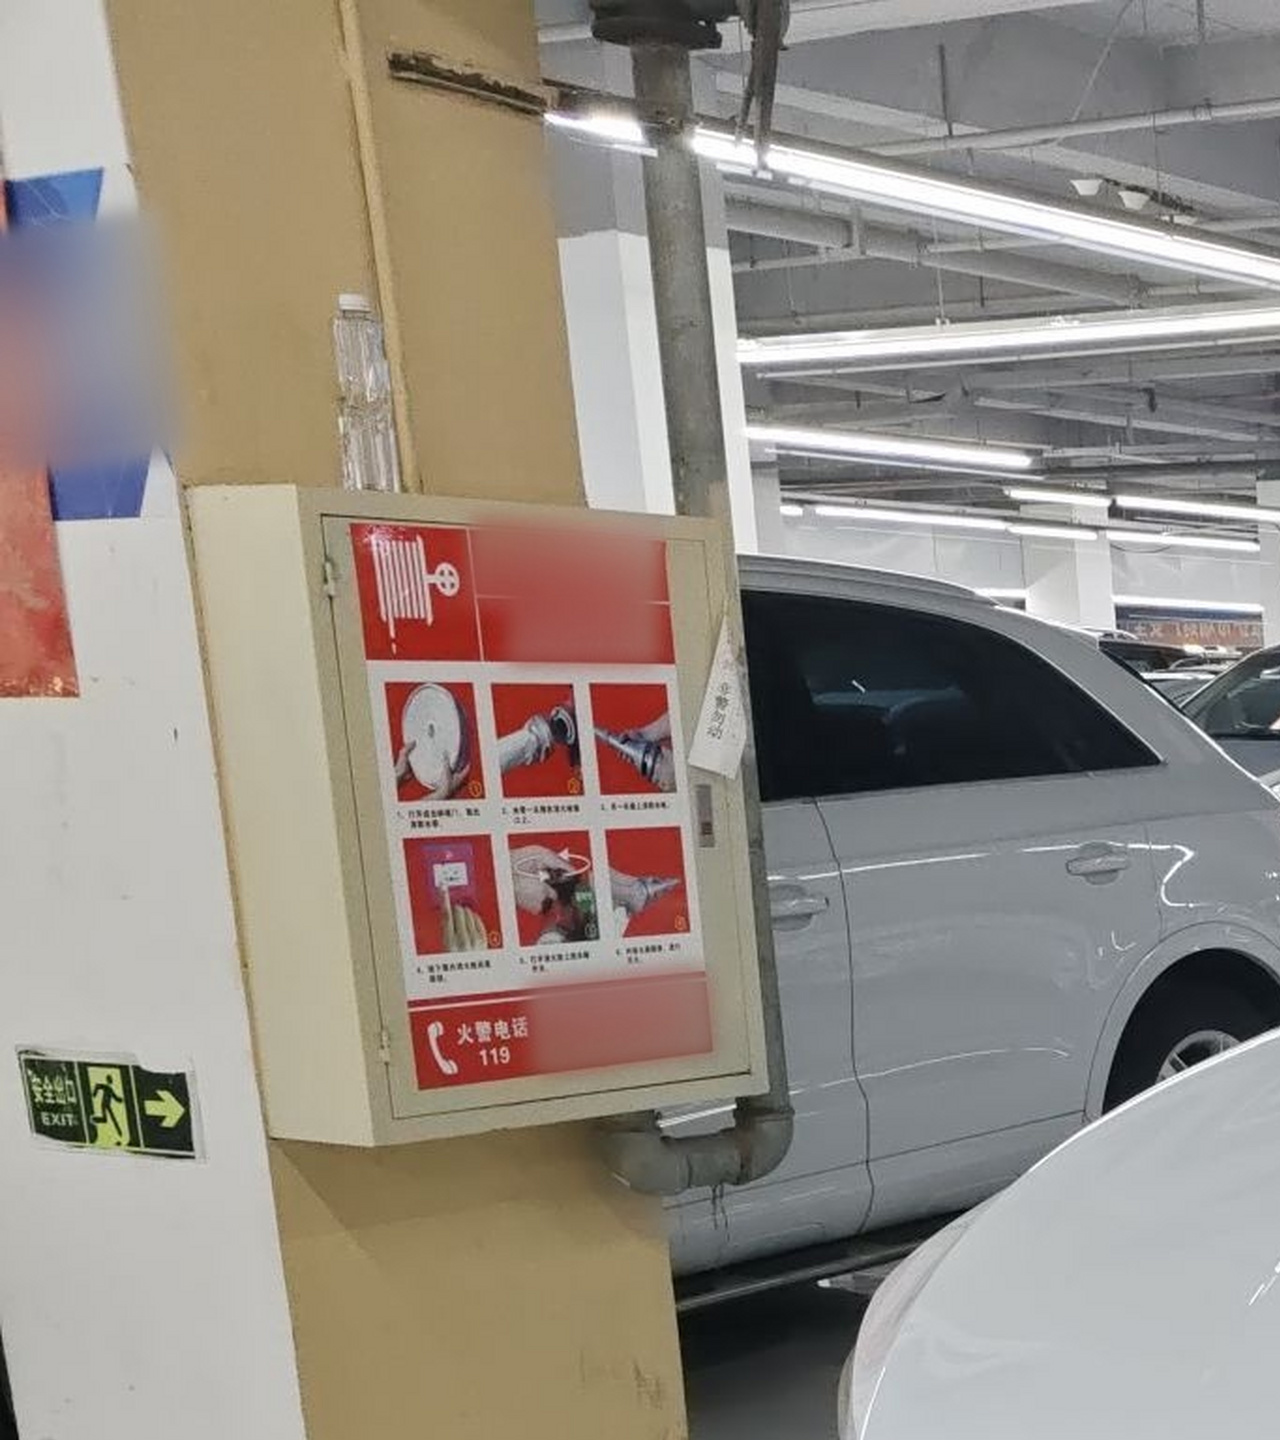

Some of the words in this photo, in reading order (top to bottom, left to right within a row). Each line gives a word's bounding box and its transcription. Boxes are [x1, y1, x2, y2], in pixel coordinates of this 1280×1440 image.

[457, 1017, 528, 1045] 火警电话
[480, 1046, 511, 1066] 119
[31, 1073, 77, 1104] 安全出口
[41, 1112, 74, 1127] EXIT
